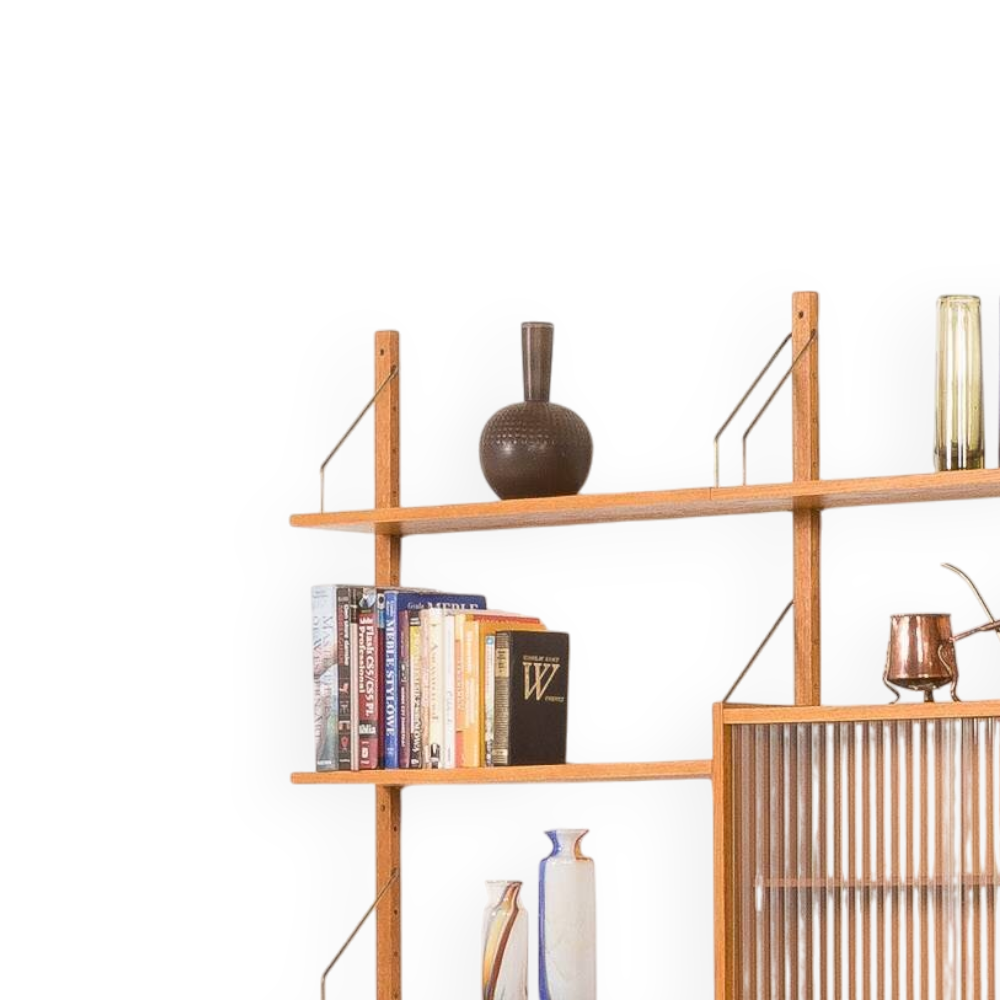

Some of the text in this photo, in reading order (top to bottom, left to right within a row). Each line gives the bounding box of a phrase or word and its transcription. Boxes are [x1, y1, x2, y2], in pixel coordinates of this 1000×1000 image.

[358, 625, 366, 694] Professional
[365, 625, 375, 655] Flash
[386, 619, 395, 666] MEBLE
[365, 655, 375, 701] CS5/CS5
[522, 662, 561, 701] W
[386, 670, 395, 736] STYLOWE
